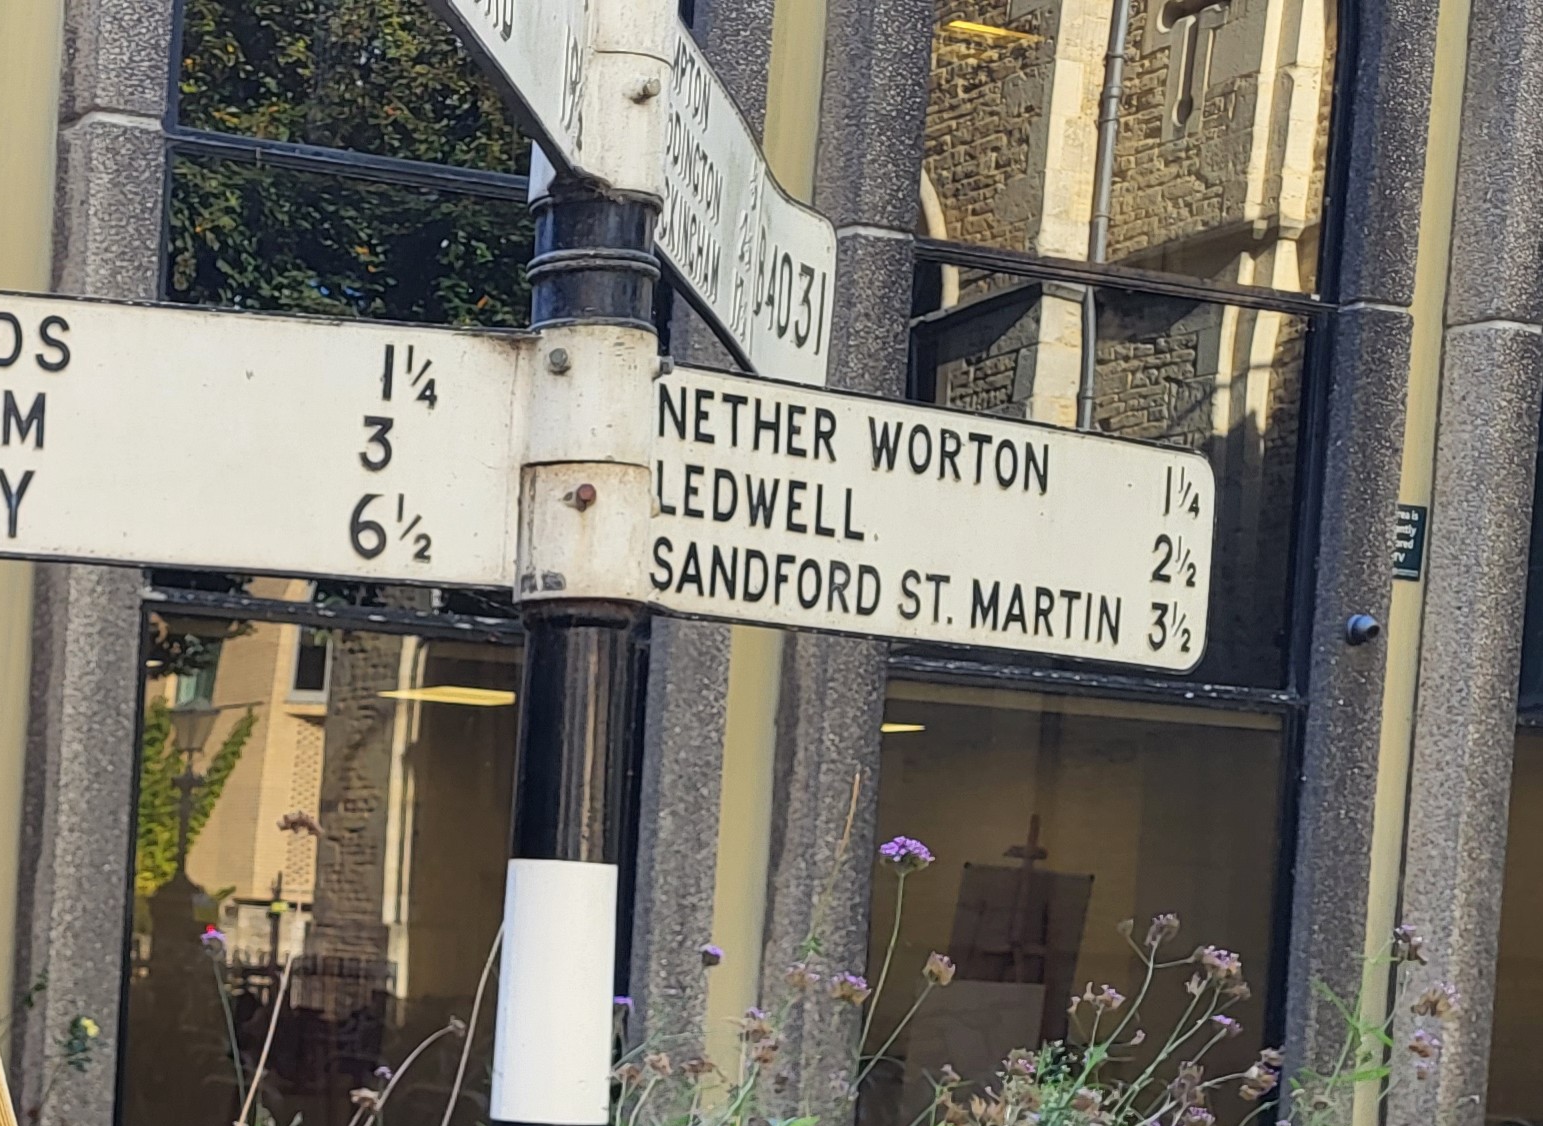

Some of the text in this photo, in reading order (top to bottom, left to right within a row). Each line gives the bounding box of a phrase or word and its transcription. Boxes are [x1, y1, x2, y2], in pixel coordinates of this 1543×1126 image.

[359, 415, 394, 472] 3
[658, 383, 837, 462] NETHER
[867, 416, 1049, 495] WORTON
[656, 459, 865, 541] LEDWELL
[649, 536, 882, 617] SANDFORD
[897, 569, 954, 626] ST.
[970, 578, 1122, 645] MARTIN
